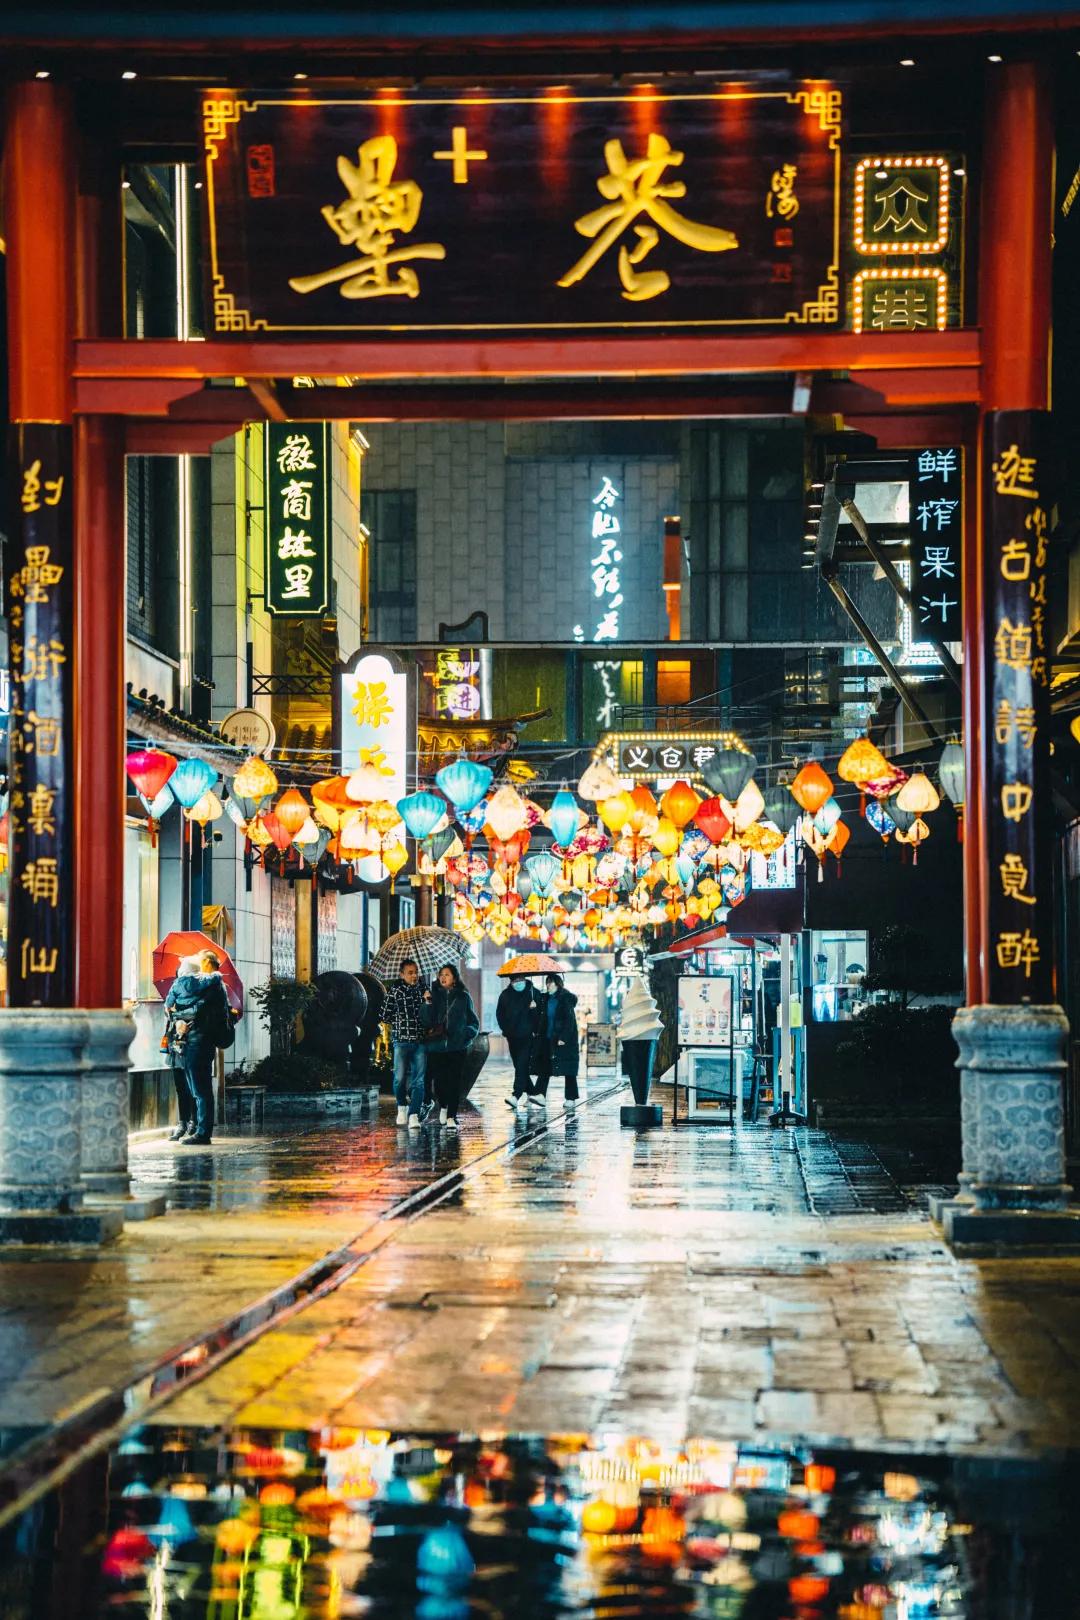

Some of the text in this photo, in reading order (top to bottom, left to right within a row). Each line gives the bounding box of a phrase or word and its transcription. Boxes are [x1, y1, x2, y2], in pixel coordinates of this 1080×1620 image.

[276, 434, 317, 599] 徽商故里
[916, 449, 959, 623] 鲜榨果汁
